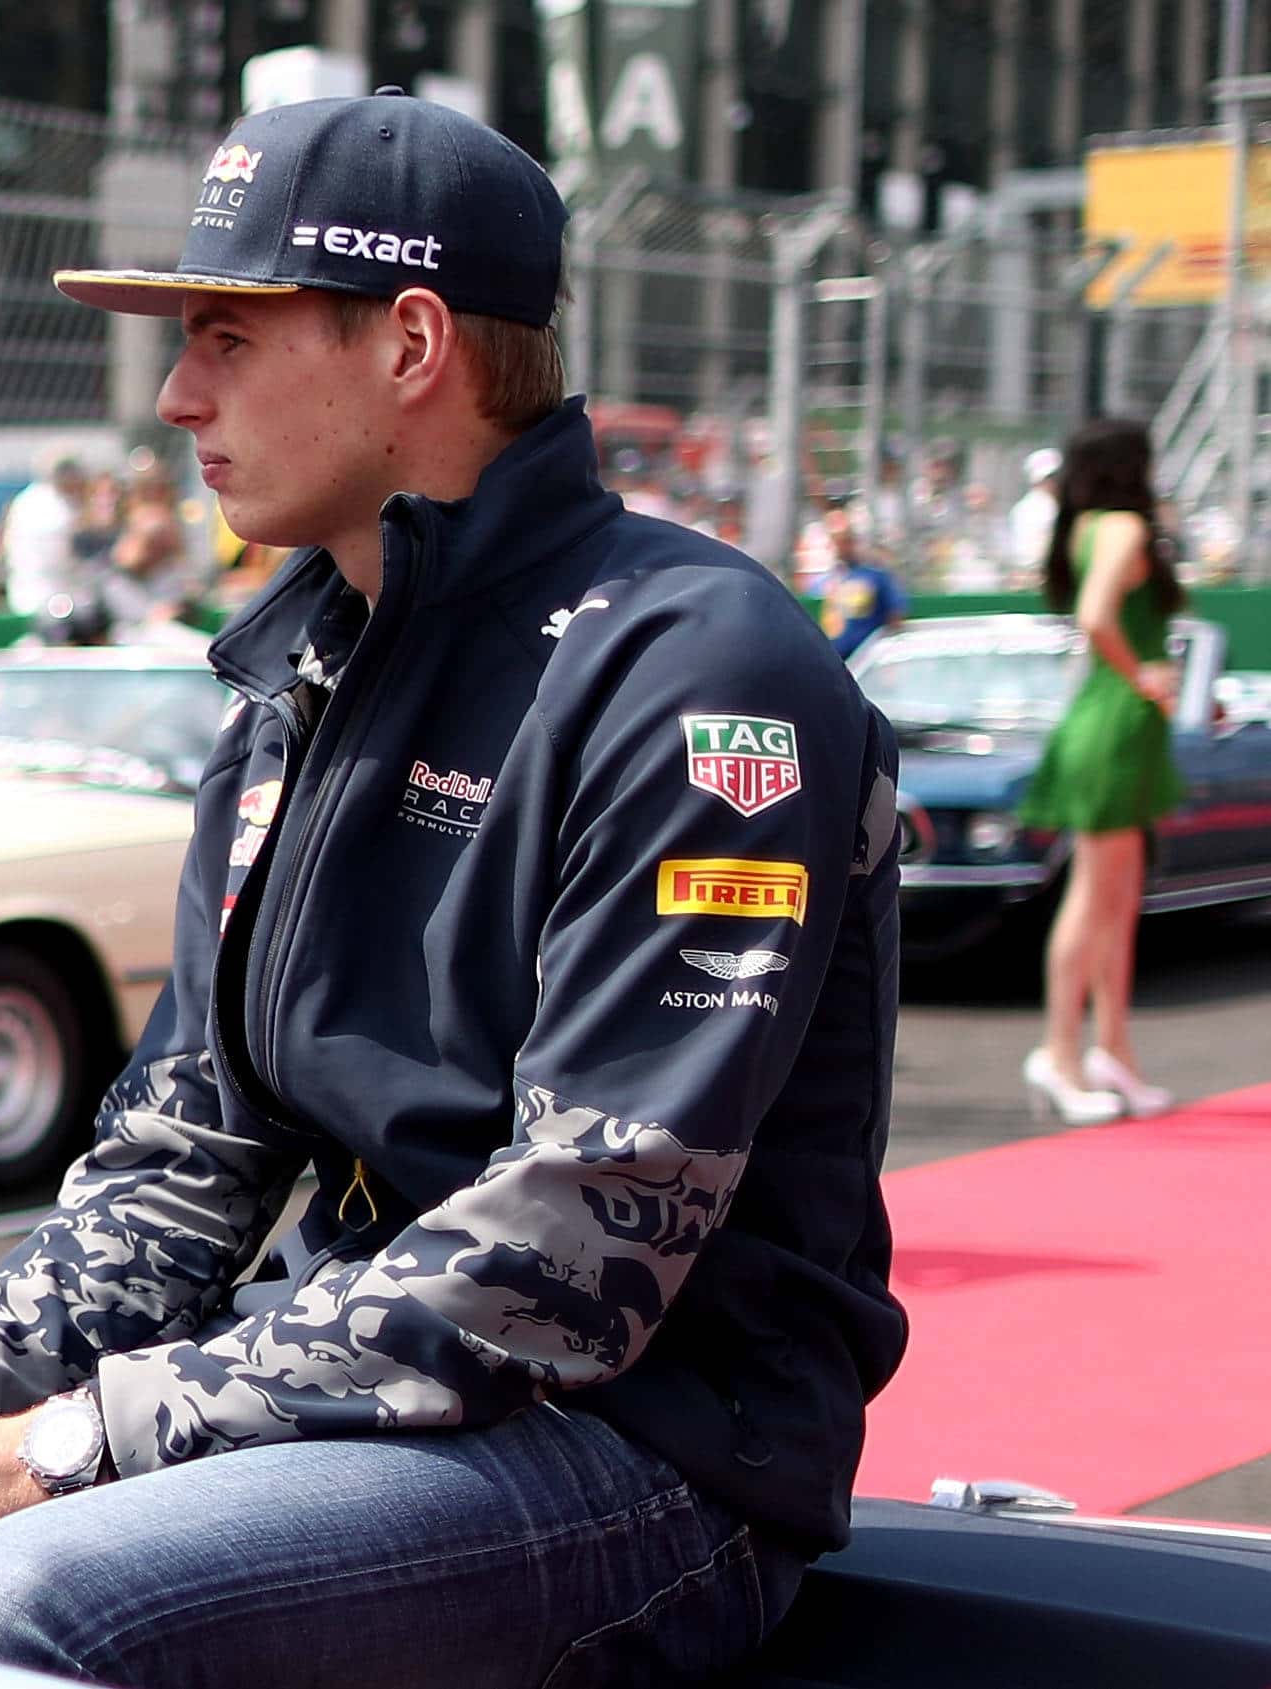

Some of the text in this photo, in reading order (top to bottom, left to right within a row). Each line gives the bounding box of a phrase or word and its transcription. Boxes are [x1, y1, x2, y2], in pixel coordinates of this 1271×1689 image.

[696, 722, 790, 755] TAG
[697, 759, 795, 807] HEUER
[403, 788, 483, 821] RAC
[397, 810, 462, 836] FORMULA
[660, 991, 725, 1009] ASTON
